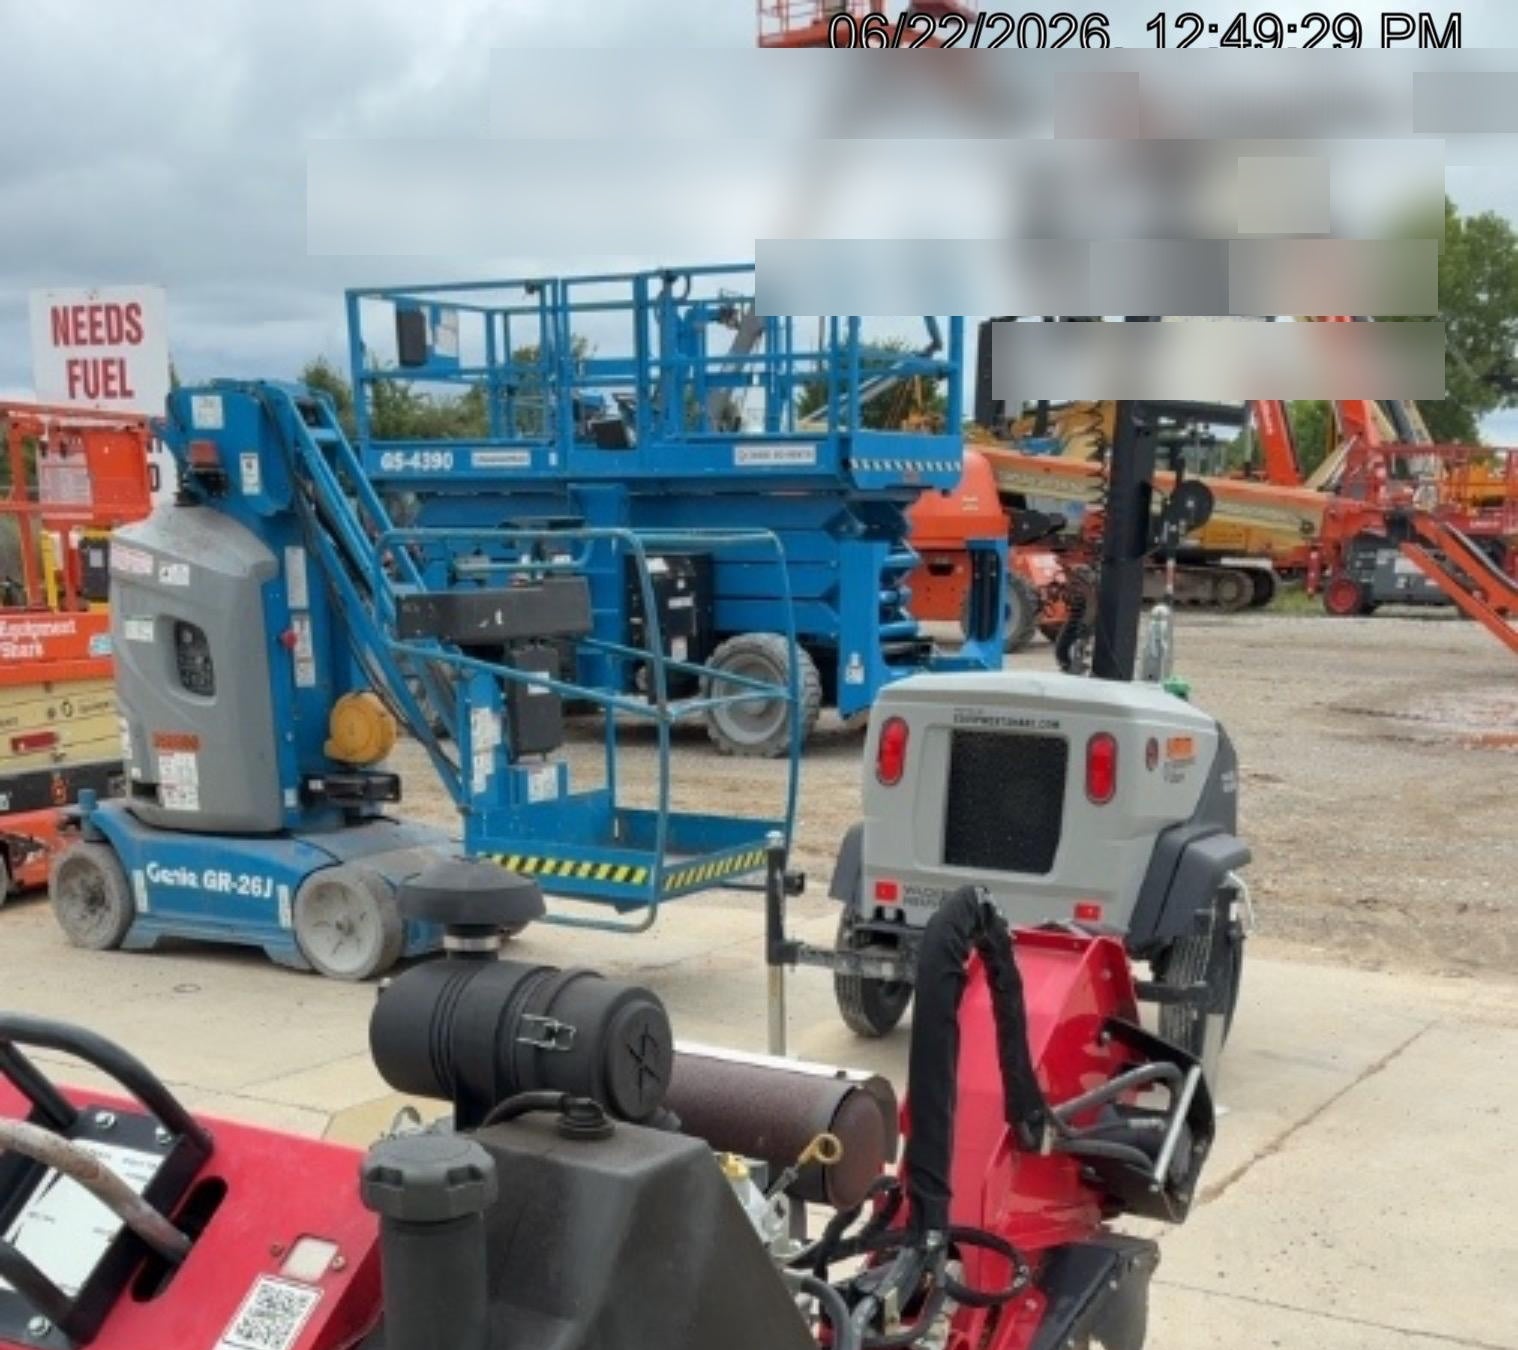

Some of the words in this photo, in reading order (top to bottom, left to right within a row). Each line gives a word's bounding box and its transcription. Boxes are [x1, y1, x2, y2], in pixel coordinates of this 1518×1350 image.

[51, 303, 144, 346] NEEDS
[66, 358, 134, 399] FUEL
[380, 451, 454, 471] GS-4390
[147, 861, 199, 888] Genie
[203, 869, 274, 898] GR-26J
